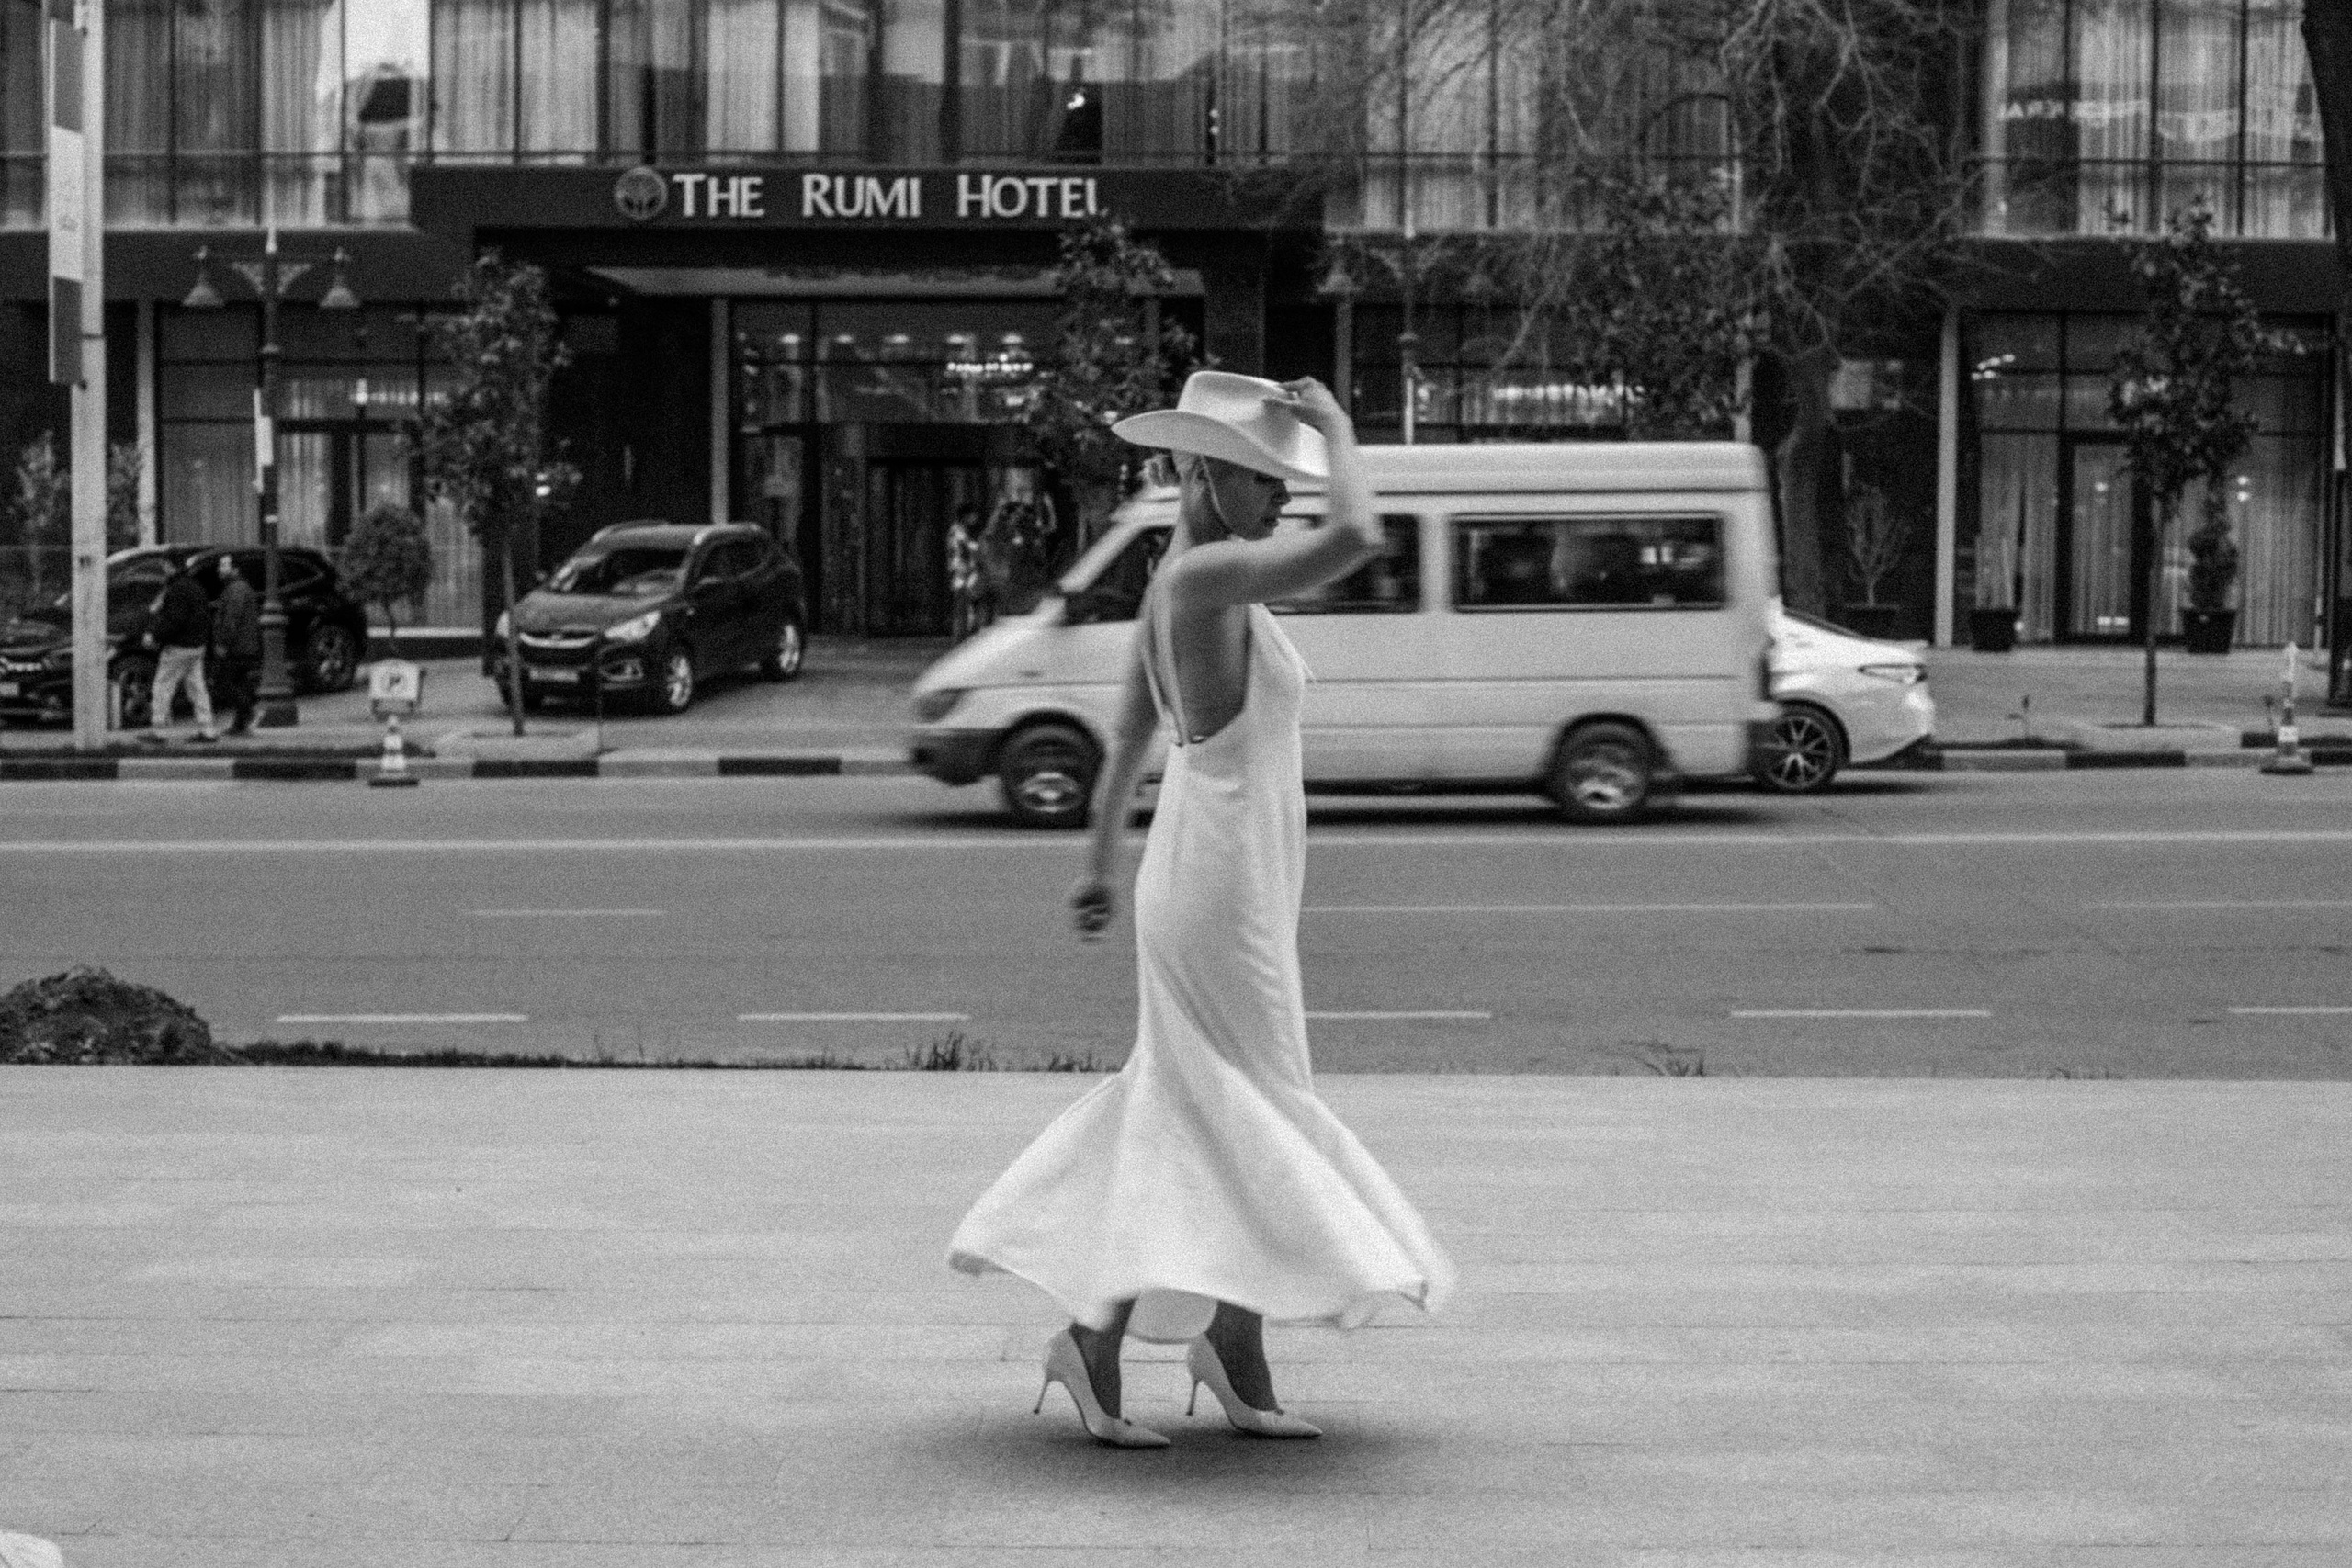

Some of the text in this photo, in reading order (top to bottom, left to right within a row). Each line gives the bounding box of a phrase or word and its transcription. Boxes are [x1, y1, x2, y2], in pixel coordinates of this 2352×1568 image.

[673, 173, 1098, 218] THE RUMI HOTEL
